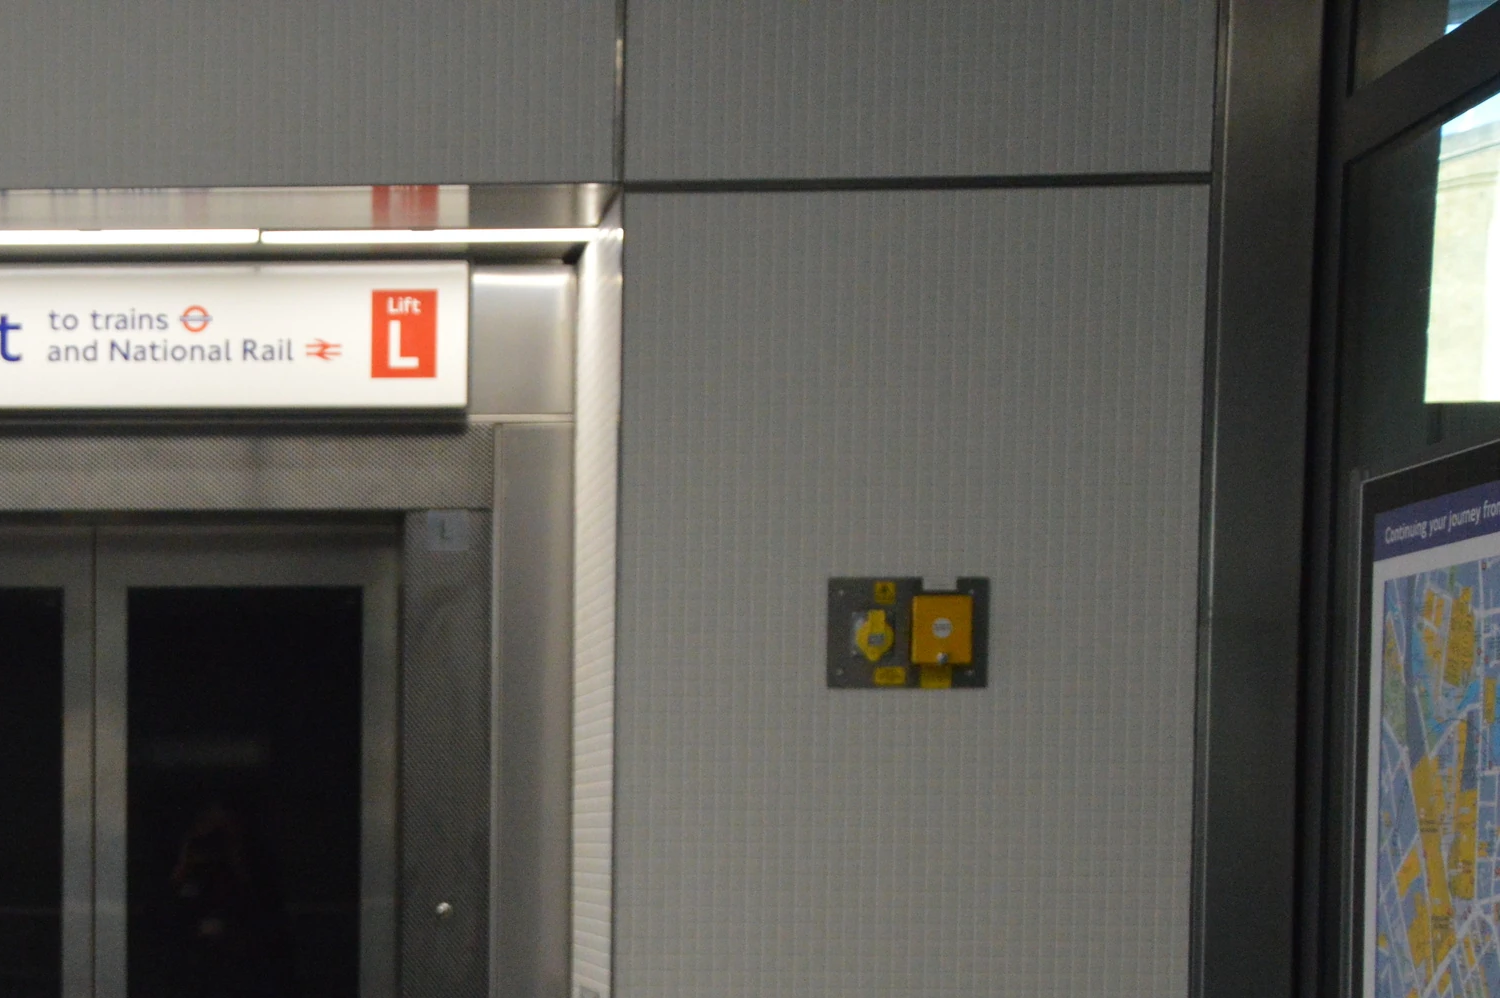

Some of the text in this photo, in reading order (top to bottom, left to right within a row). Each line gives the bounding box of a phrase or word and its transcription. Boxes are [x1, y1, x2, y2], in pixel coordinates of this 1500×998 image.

[387, 295, 421, 315] Lift
[47, 309, 78, 331] to
[90, 308, 169, 331] trains
[47, 338, 294, 363] and National Rail
[388, 320, 419, 368] L
[1385, 520, 1427, 544] Continuing
[1429, 515, 1447, 537] your
[1447, 506, 1482, 532] journey
